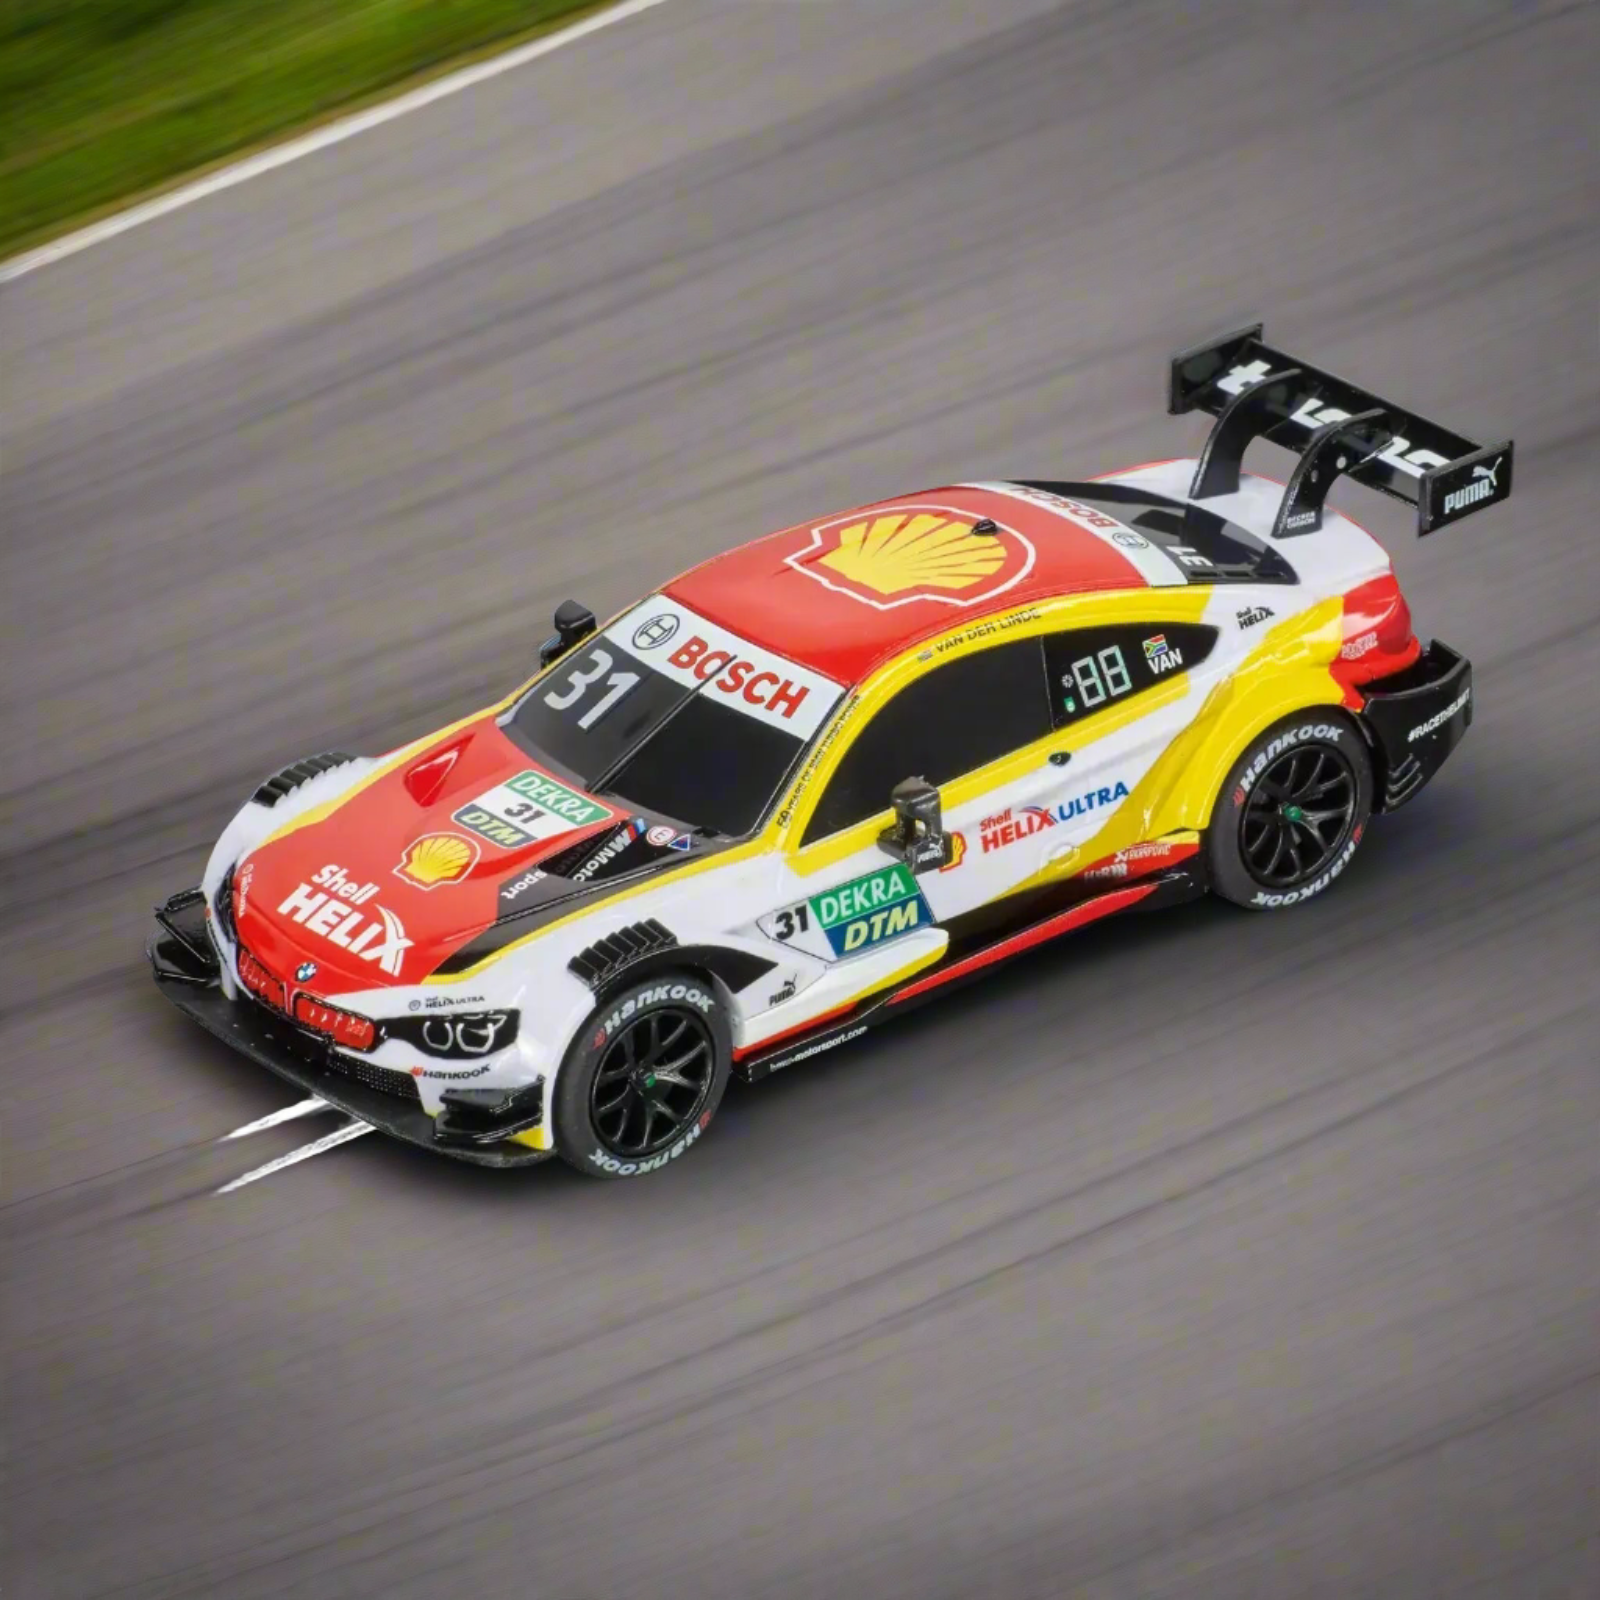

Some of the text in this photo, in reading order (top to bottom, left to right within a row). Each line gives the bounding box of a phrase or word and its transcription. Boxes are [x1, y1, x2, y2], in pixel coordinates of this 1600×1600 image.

[1444, 479, 1491, 515] PUMA
[936, 607, 1043, 654] VAN DER LINDE
[1238, 606, 1275, 630] HELIX
[667, 635, 810, 720] BOSCH
[1147, 648, 1184, 676] VAN
[543, 648, 641, 731] 31
[504, 802, 547, 824] 31
[511, 775, 596, 823] DEKRA
[979, 808, 1013, 833] Shell
[980, 781, 1129, 853] HELIX ULTRA
[460, 811, 521, 846] DTM
[310, 863, 380, 905] Shell
[819, 870, 906, 925] DEKRA
[276, 882, 416, 977] HELIX
[774, 904, 810, 942] 31
[843, 900, 919, 952] DTM
